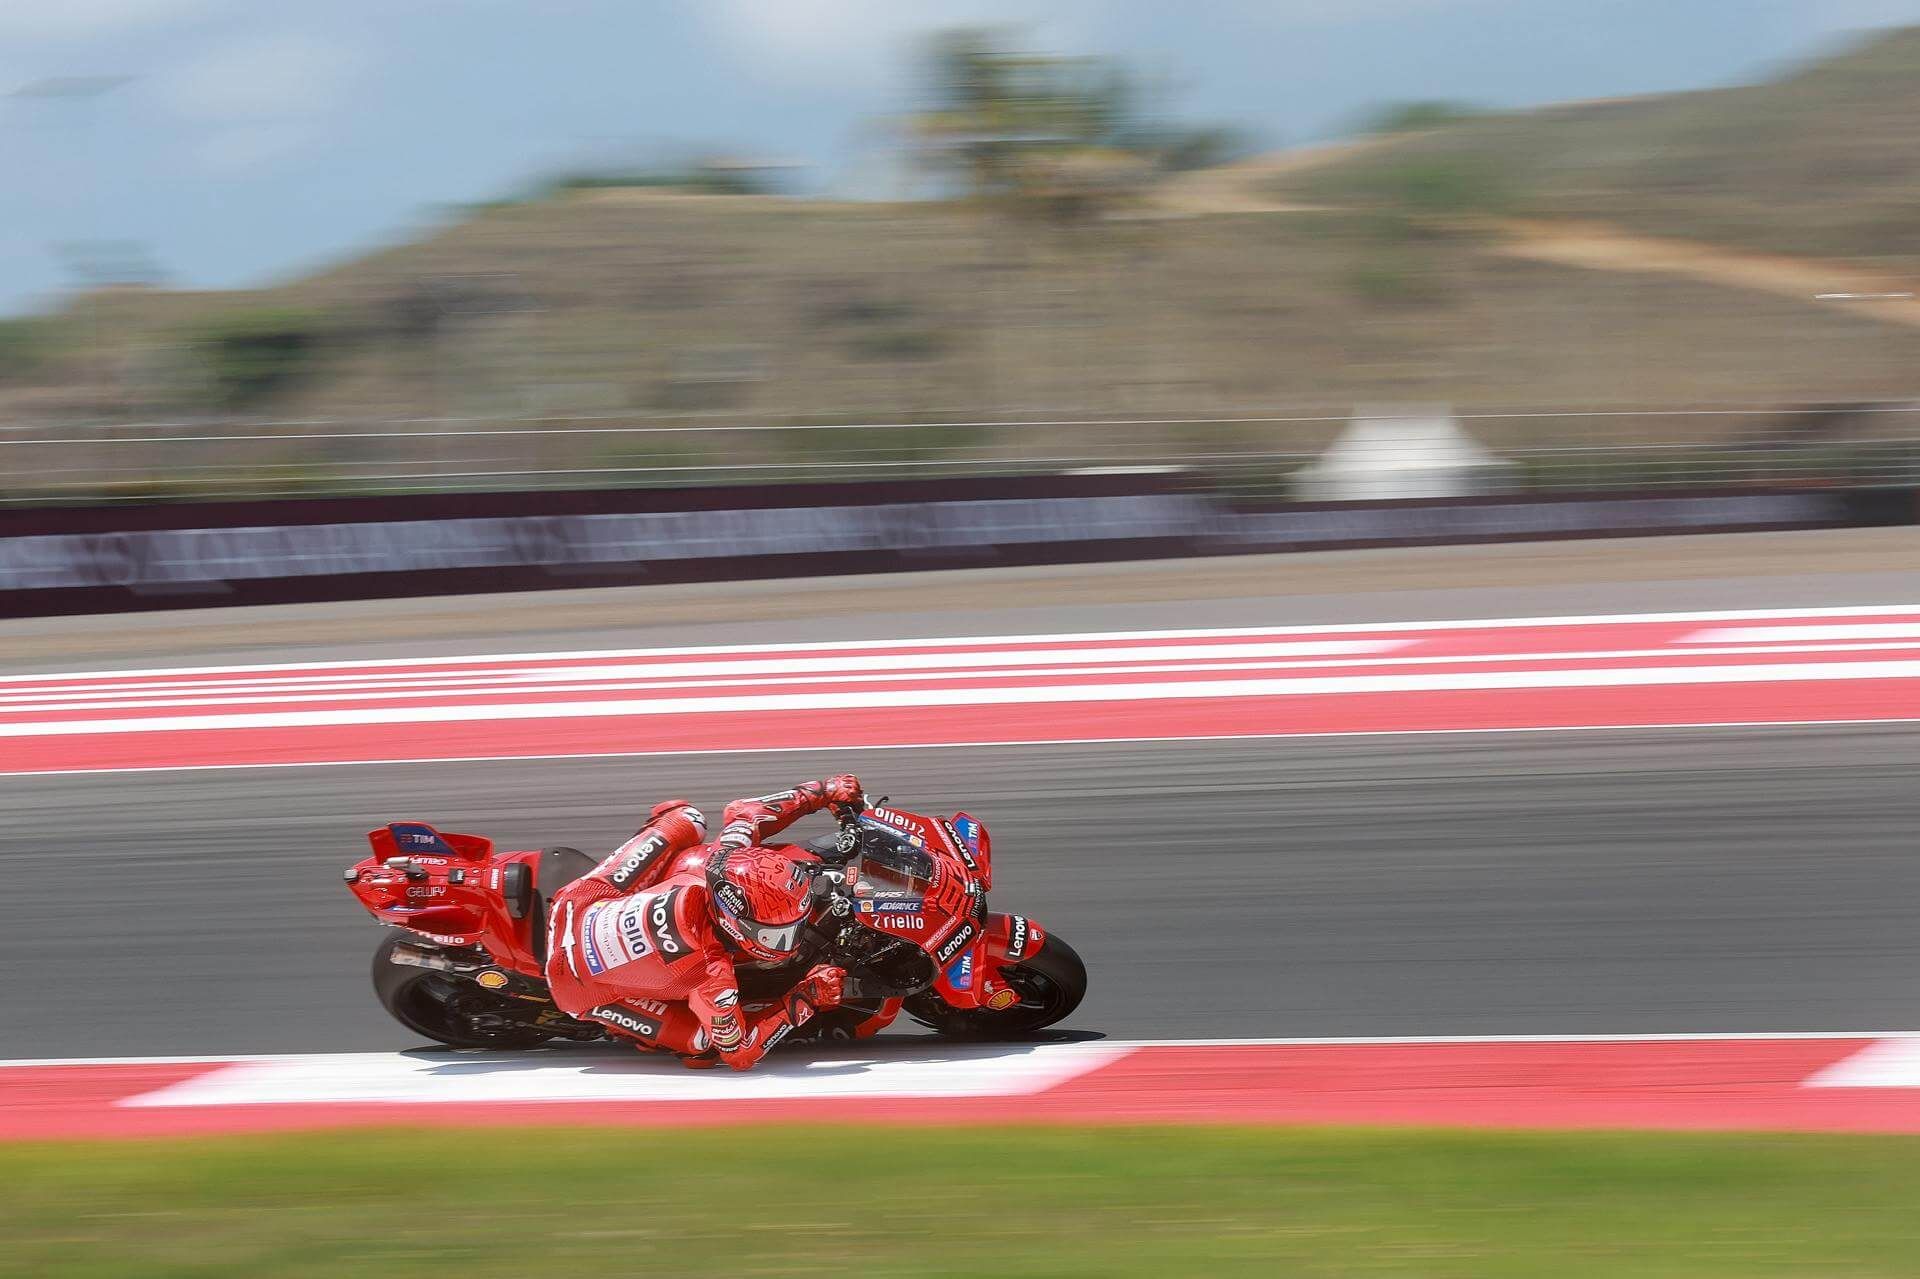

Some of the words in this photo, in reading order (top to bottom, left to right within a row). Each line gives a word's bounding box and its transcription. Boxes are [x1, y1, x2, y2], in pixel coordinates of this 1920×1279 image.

[412, 834, 434, 845] TIM
[967, 822, 977, 838] TIM
[944, 821, 975, 868] Lenovo
[613, 836, 663, 882] Lenovo
[878, 901, 921, 911] ADVANCE
[883, 914, 924, 930] riello
[936, 925, 973, 962] Lenovo
[961, 955, 972, 974] TIM
[591, 1006, 653, 1036] Lenovo
